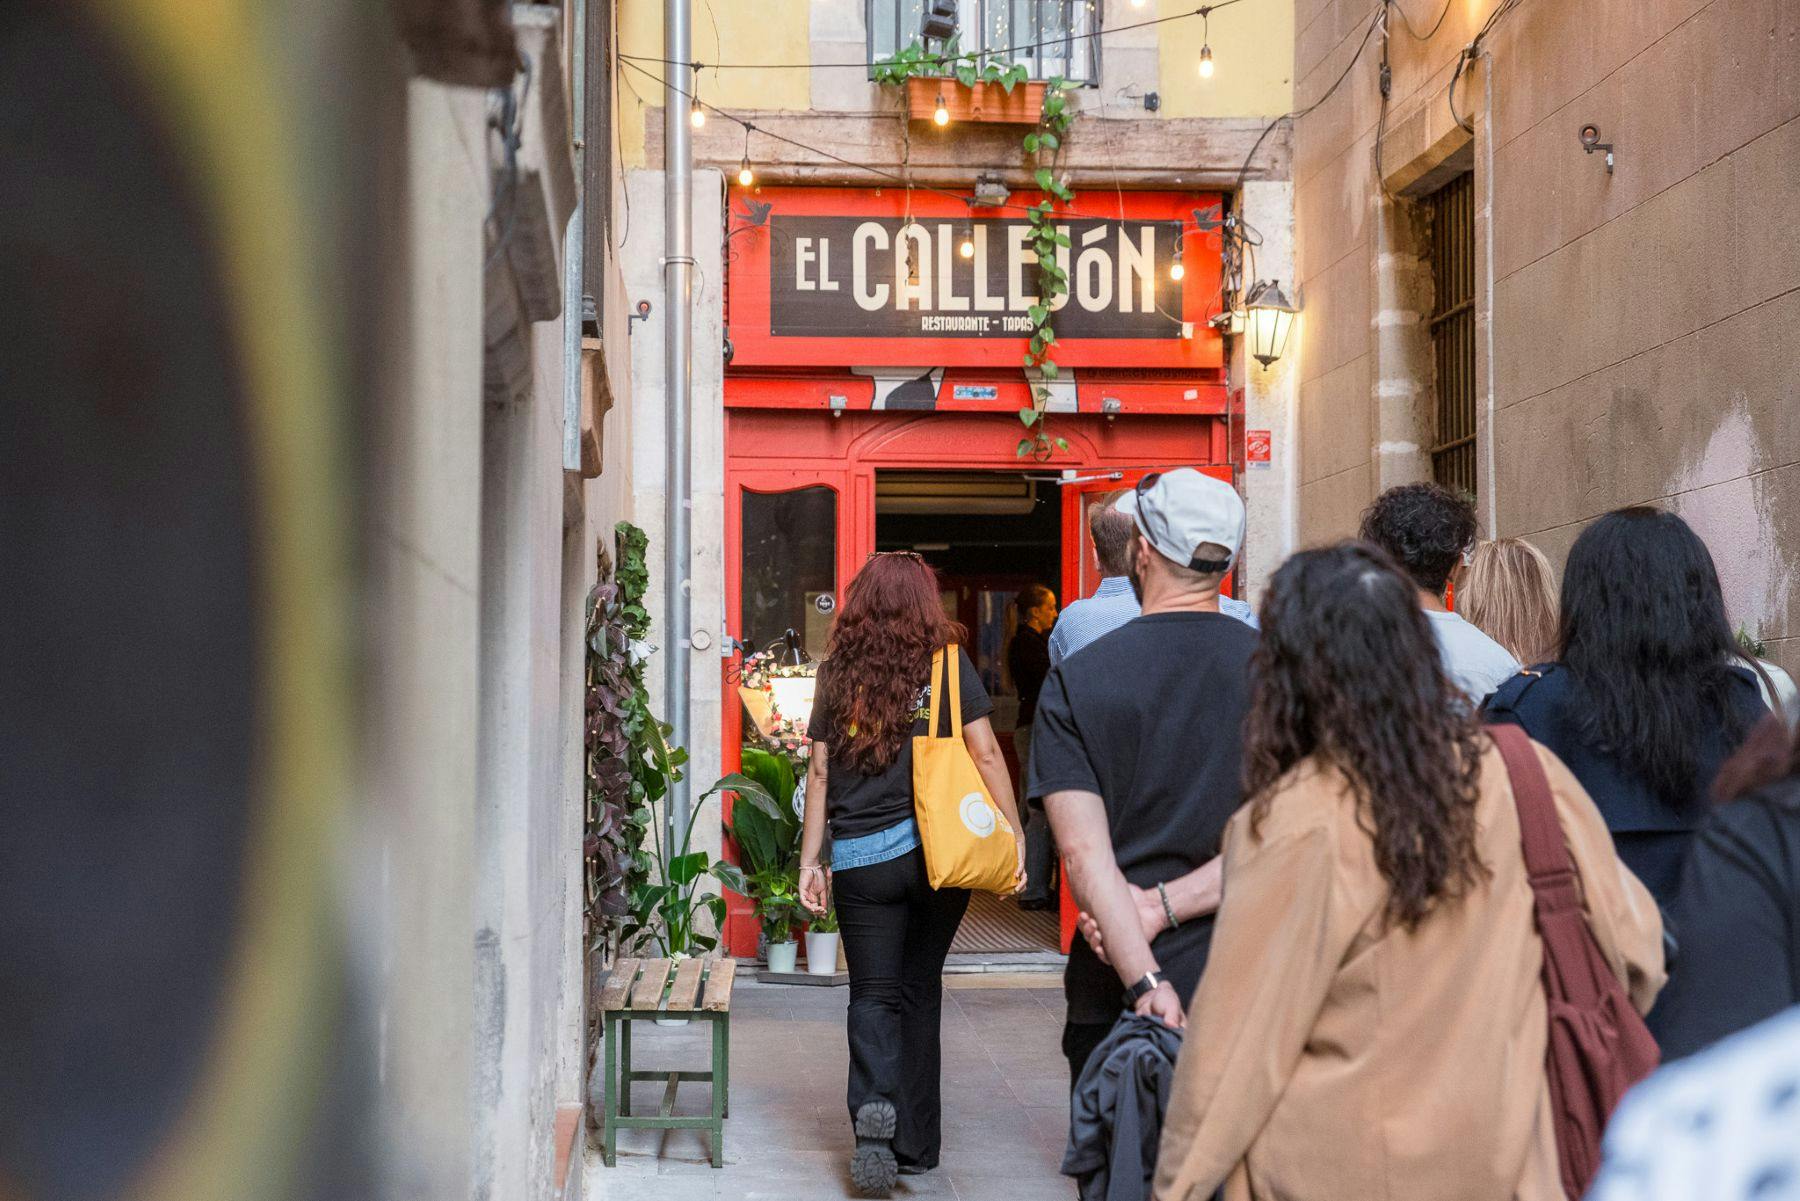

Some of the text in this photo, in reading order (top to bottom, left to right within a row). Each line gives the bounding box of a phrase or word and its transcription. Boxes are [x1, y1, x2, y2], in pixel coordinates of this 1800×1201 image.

[796, 237, 839, 290] EL
[921, 315, 990, 332] RESTAURANTE
[1002, 316, 1034, 332] TAPAS
